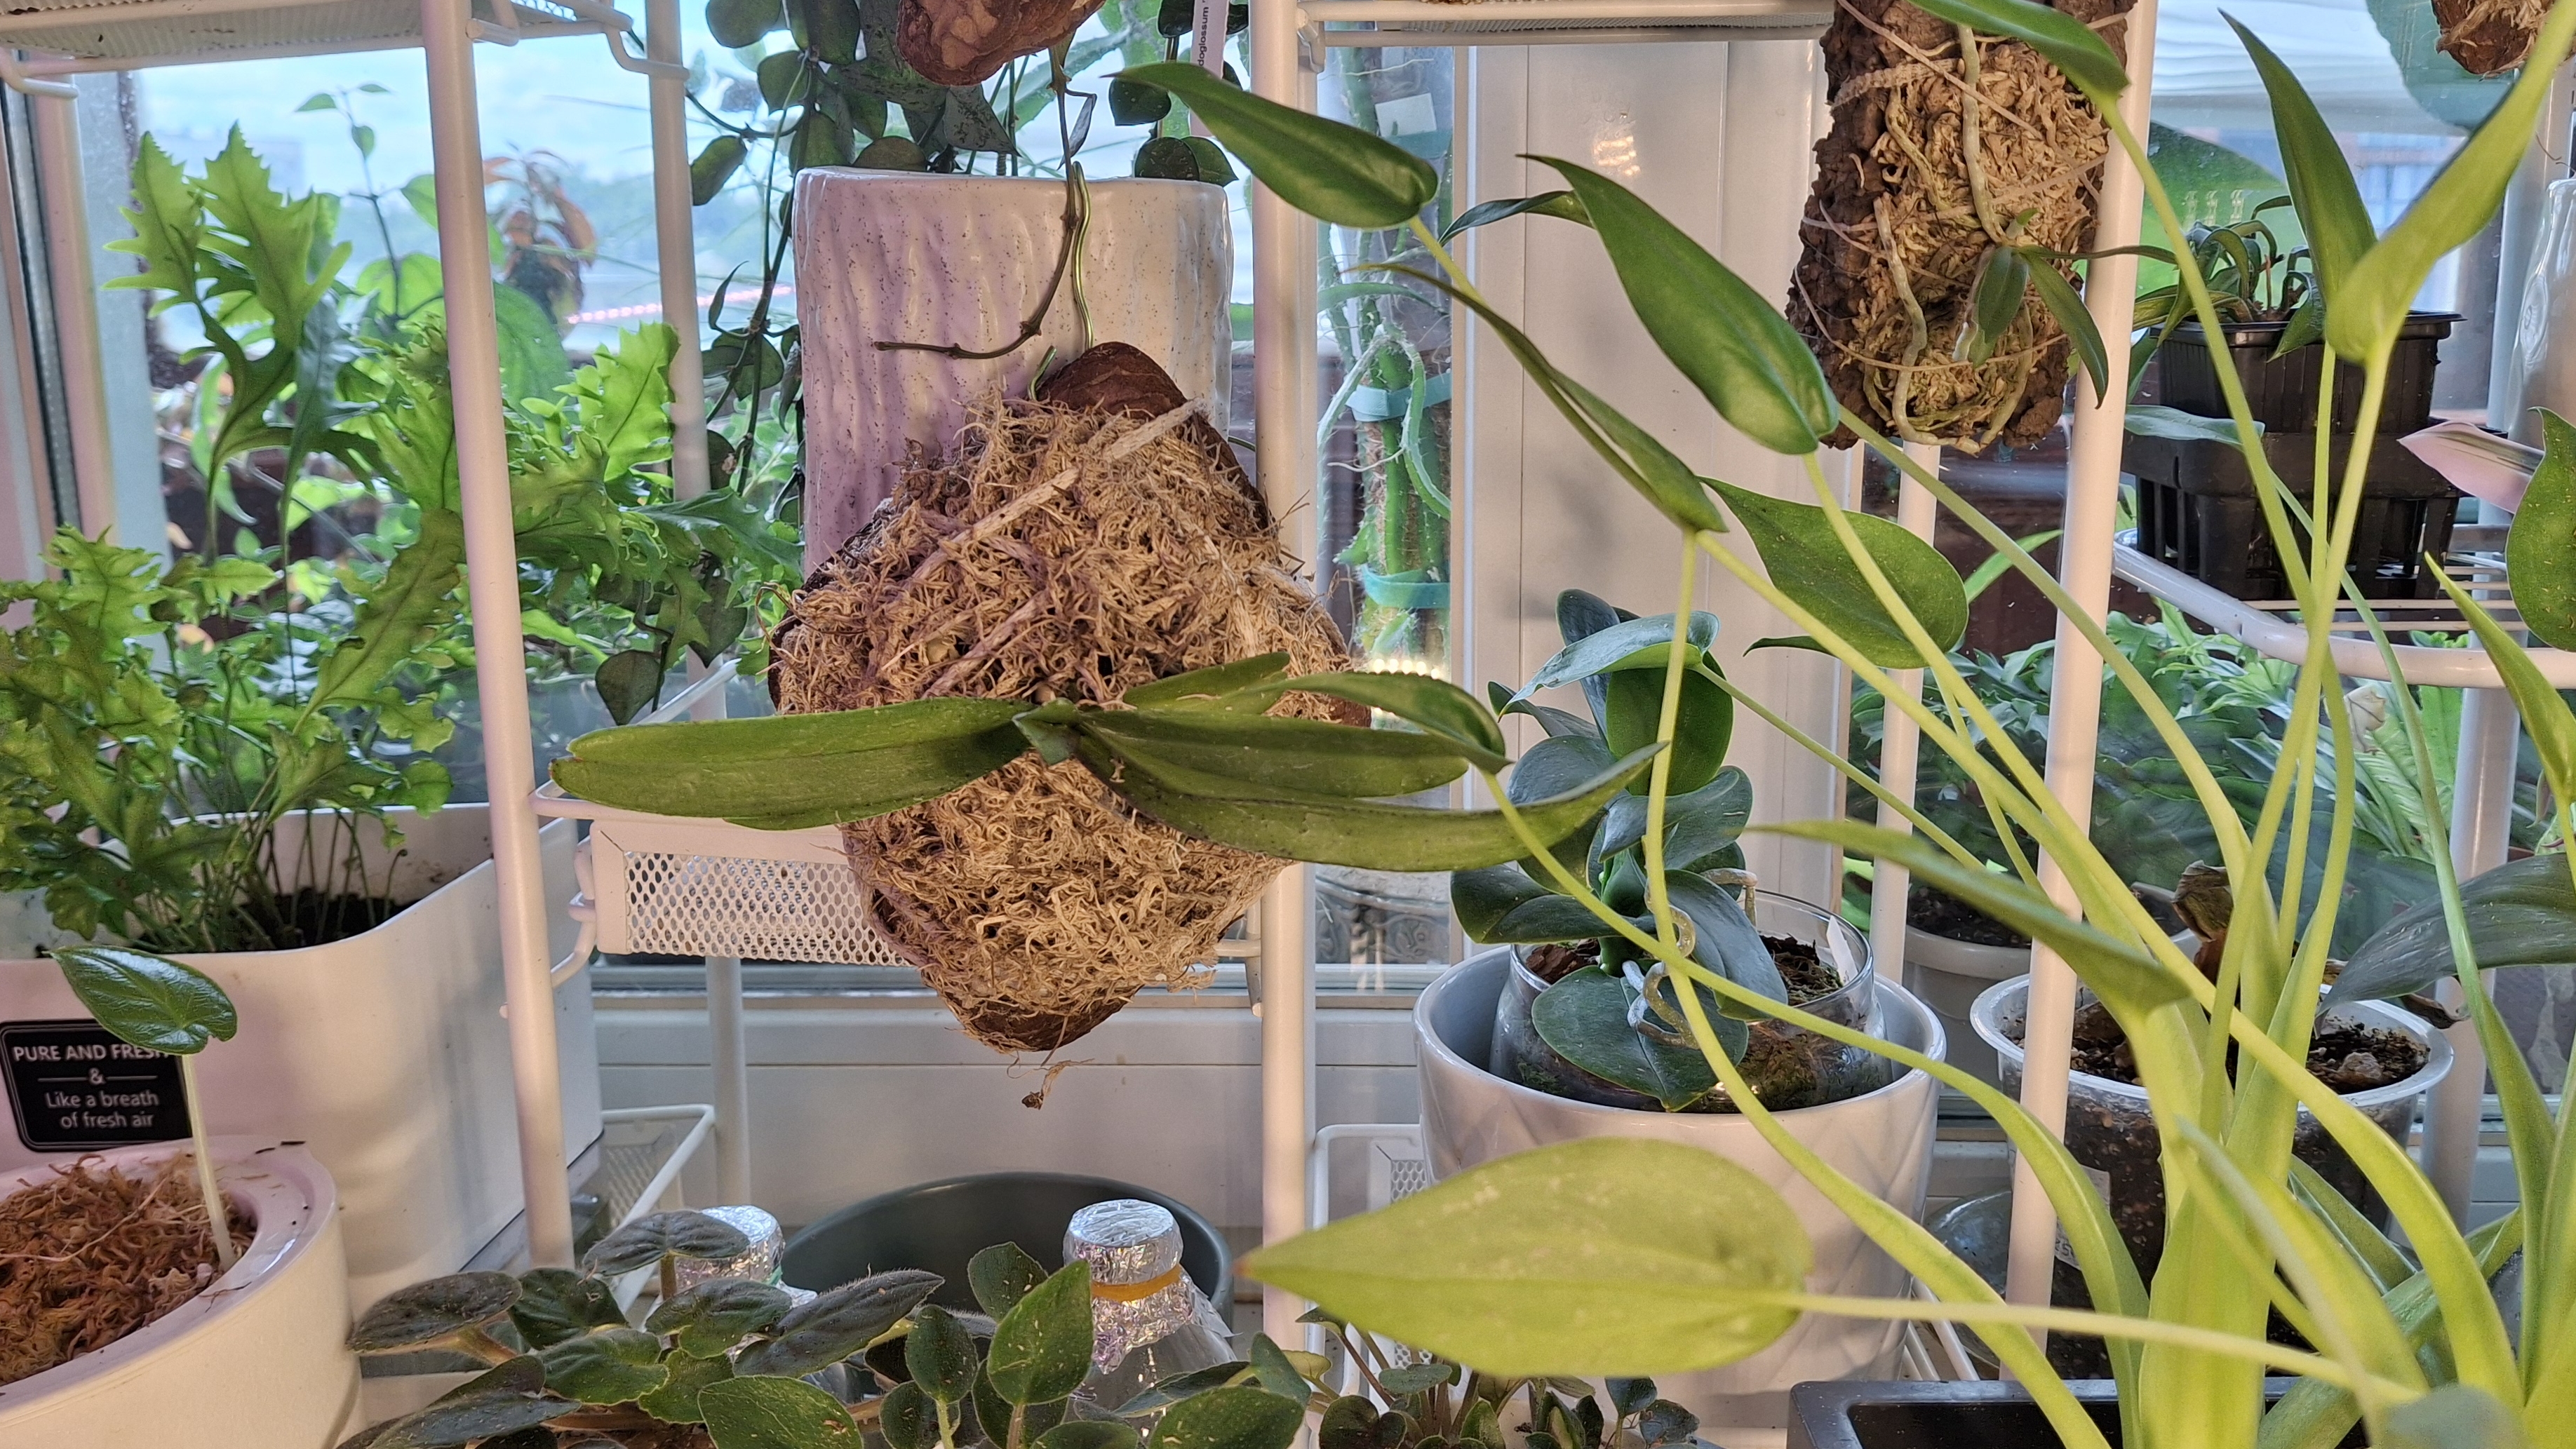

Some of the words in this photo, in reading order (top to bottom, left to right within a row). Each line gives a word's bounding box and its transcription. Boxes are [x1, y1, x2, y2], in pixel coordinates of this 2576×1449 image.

[13, 1045, 61, 1061] PURE
[65, 1044, 106, 1060] AND
[88, 1067, 105, 1084] &
[44, 1091, 81, 1108] Like
[86, 1093, 97, 1107] a
[100, 1090, 159, 1106] breath
[60, 1112, 78, 1128] of
[83, 1111, 127, 1128] fresh
[132, 1111, 154, 1127] air
